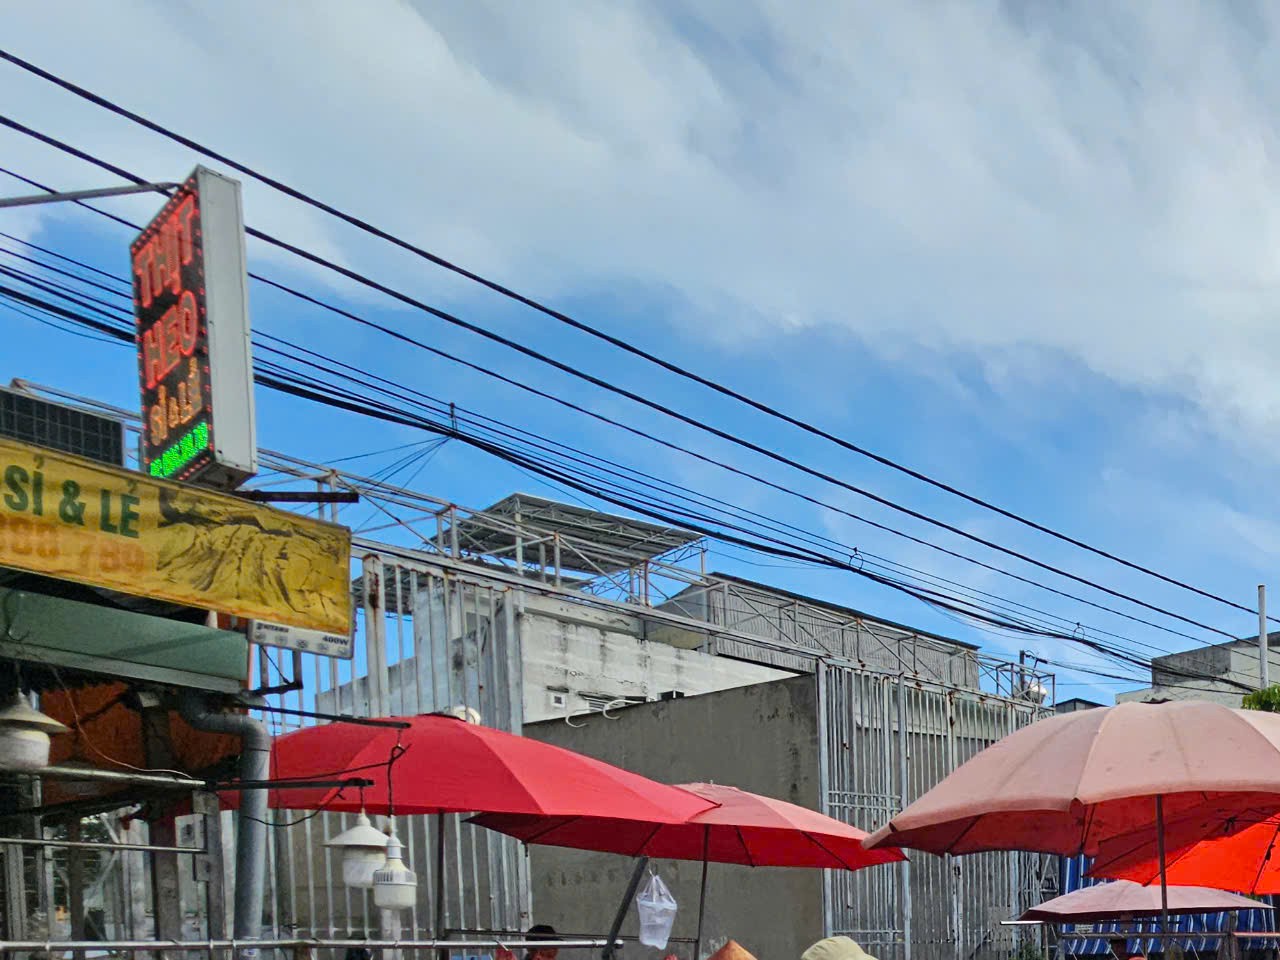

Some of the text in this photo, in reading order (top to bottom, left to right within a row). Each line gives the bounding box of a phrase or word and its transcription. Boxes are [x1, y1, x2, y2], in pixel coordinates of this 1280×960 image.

[134, 194, 194, 308] THỊT
[143, 290, 198, 389] HEO
[3, 455, 140, 539] SỈ & LẺ
[322, 635, 349, 646] 400W
